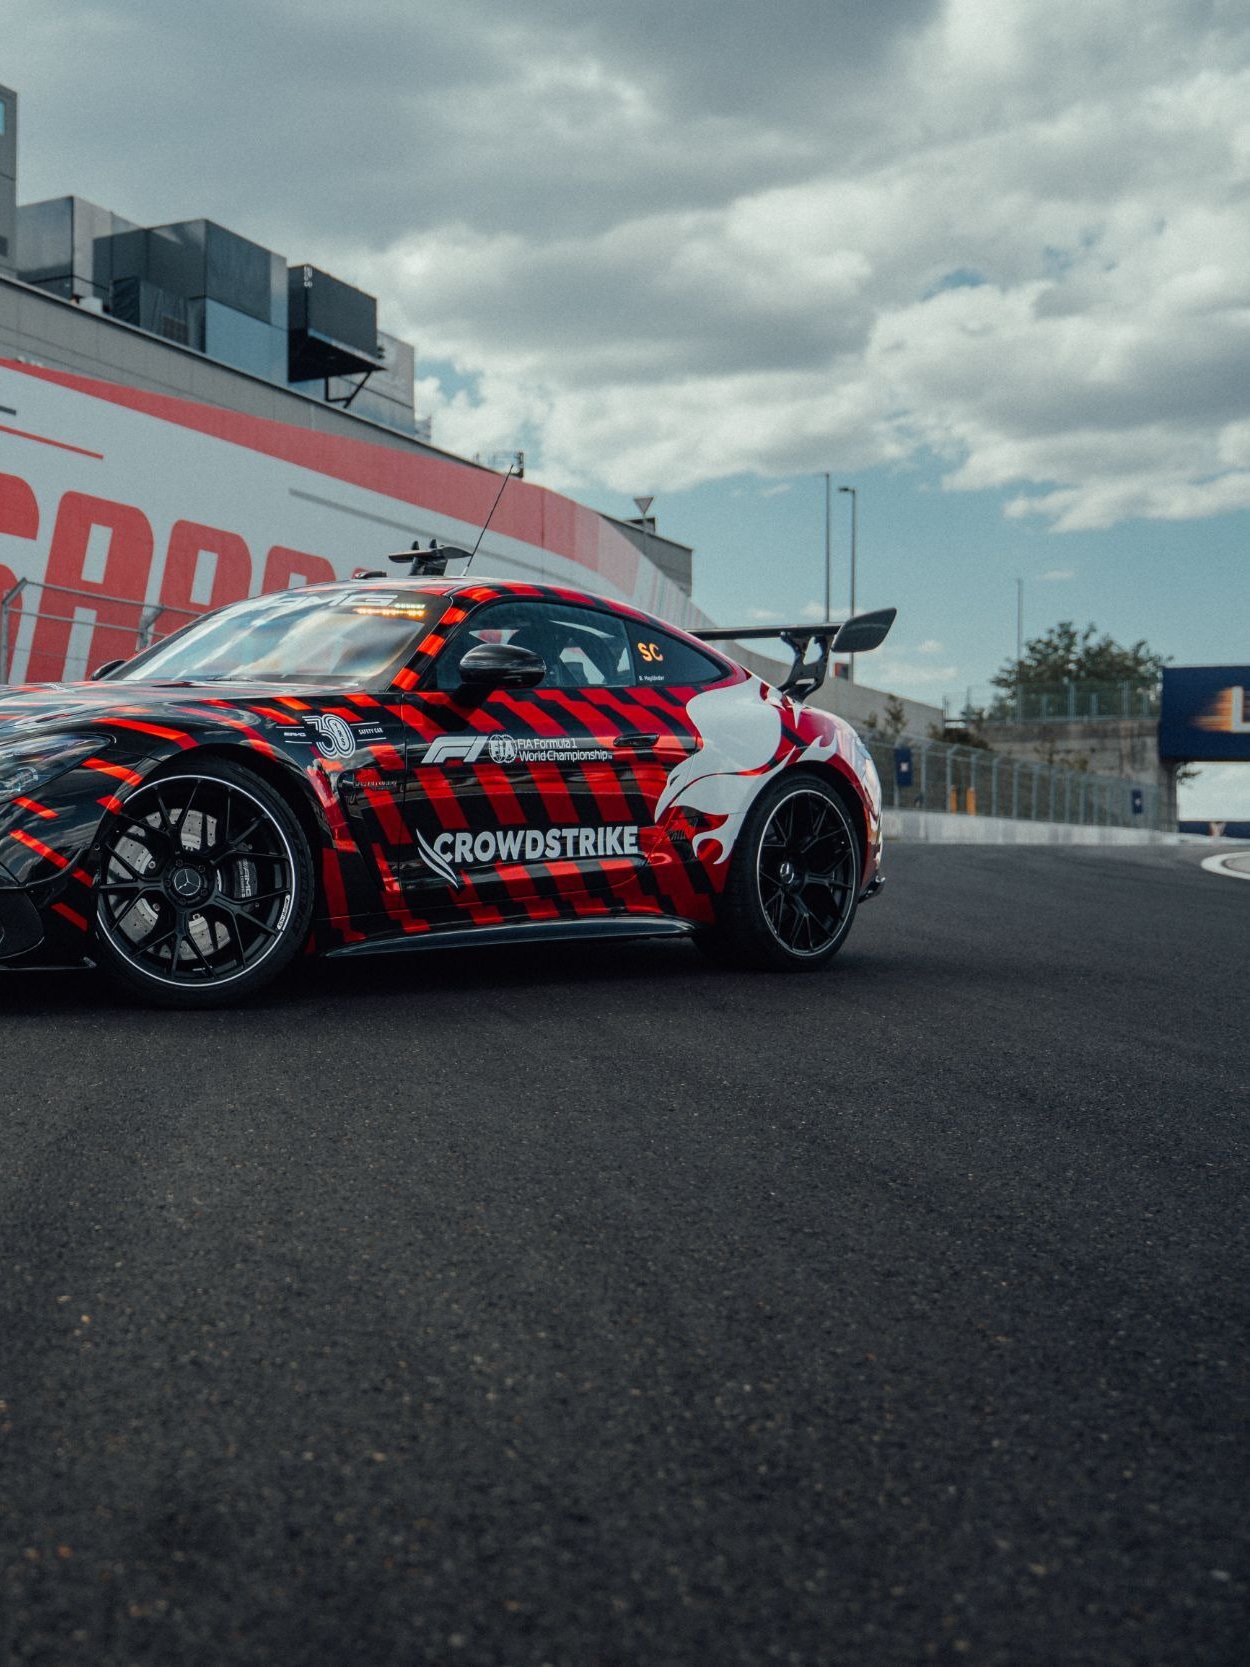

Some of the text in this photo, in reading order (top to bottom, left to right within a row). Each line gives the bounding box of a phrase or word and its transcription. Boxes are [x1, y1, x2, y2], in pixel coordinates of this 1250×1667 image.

[637, 642, 664, 662] SC
[518, 738, 577, 749] FIA Formula 1
[519, 749, 607, 762] World Championship
[434, 825, 638, 863] CROWDSTRIKE
